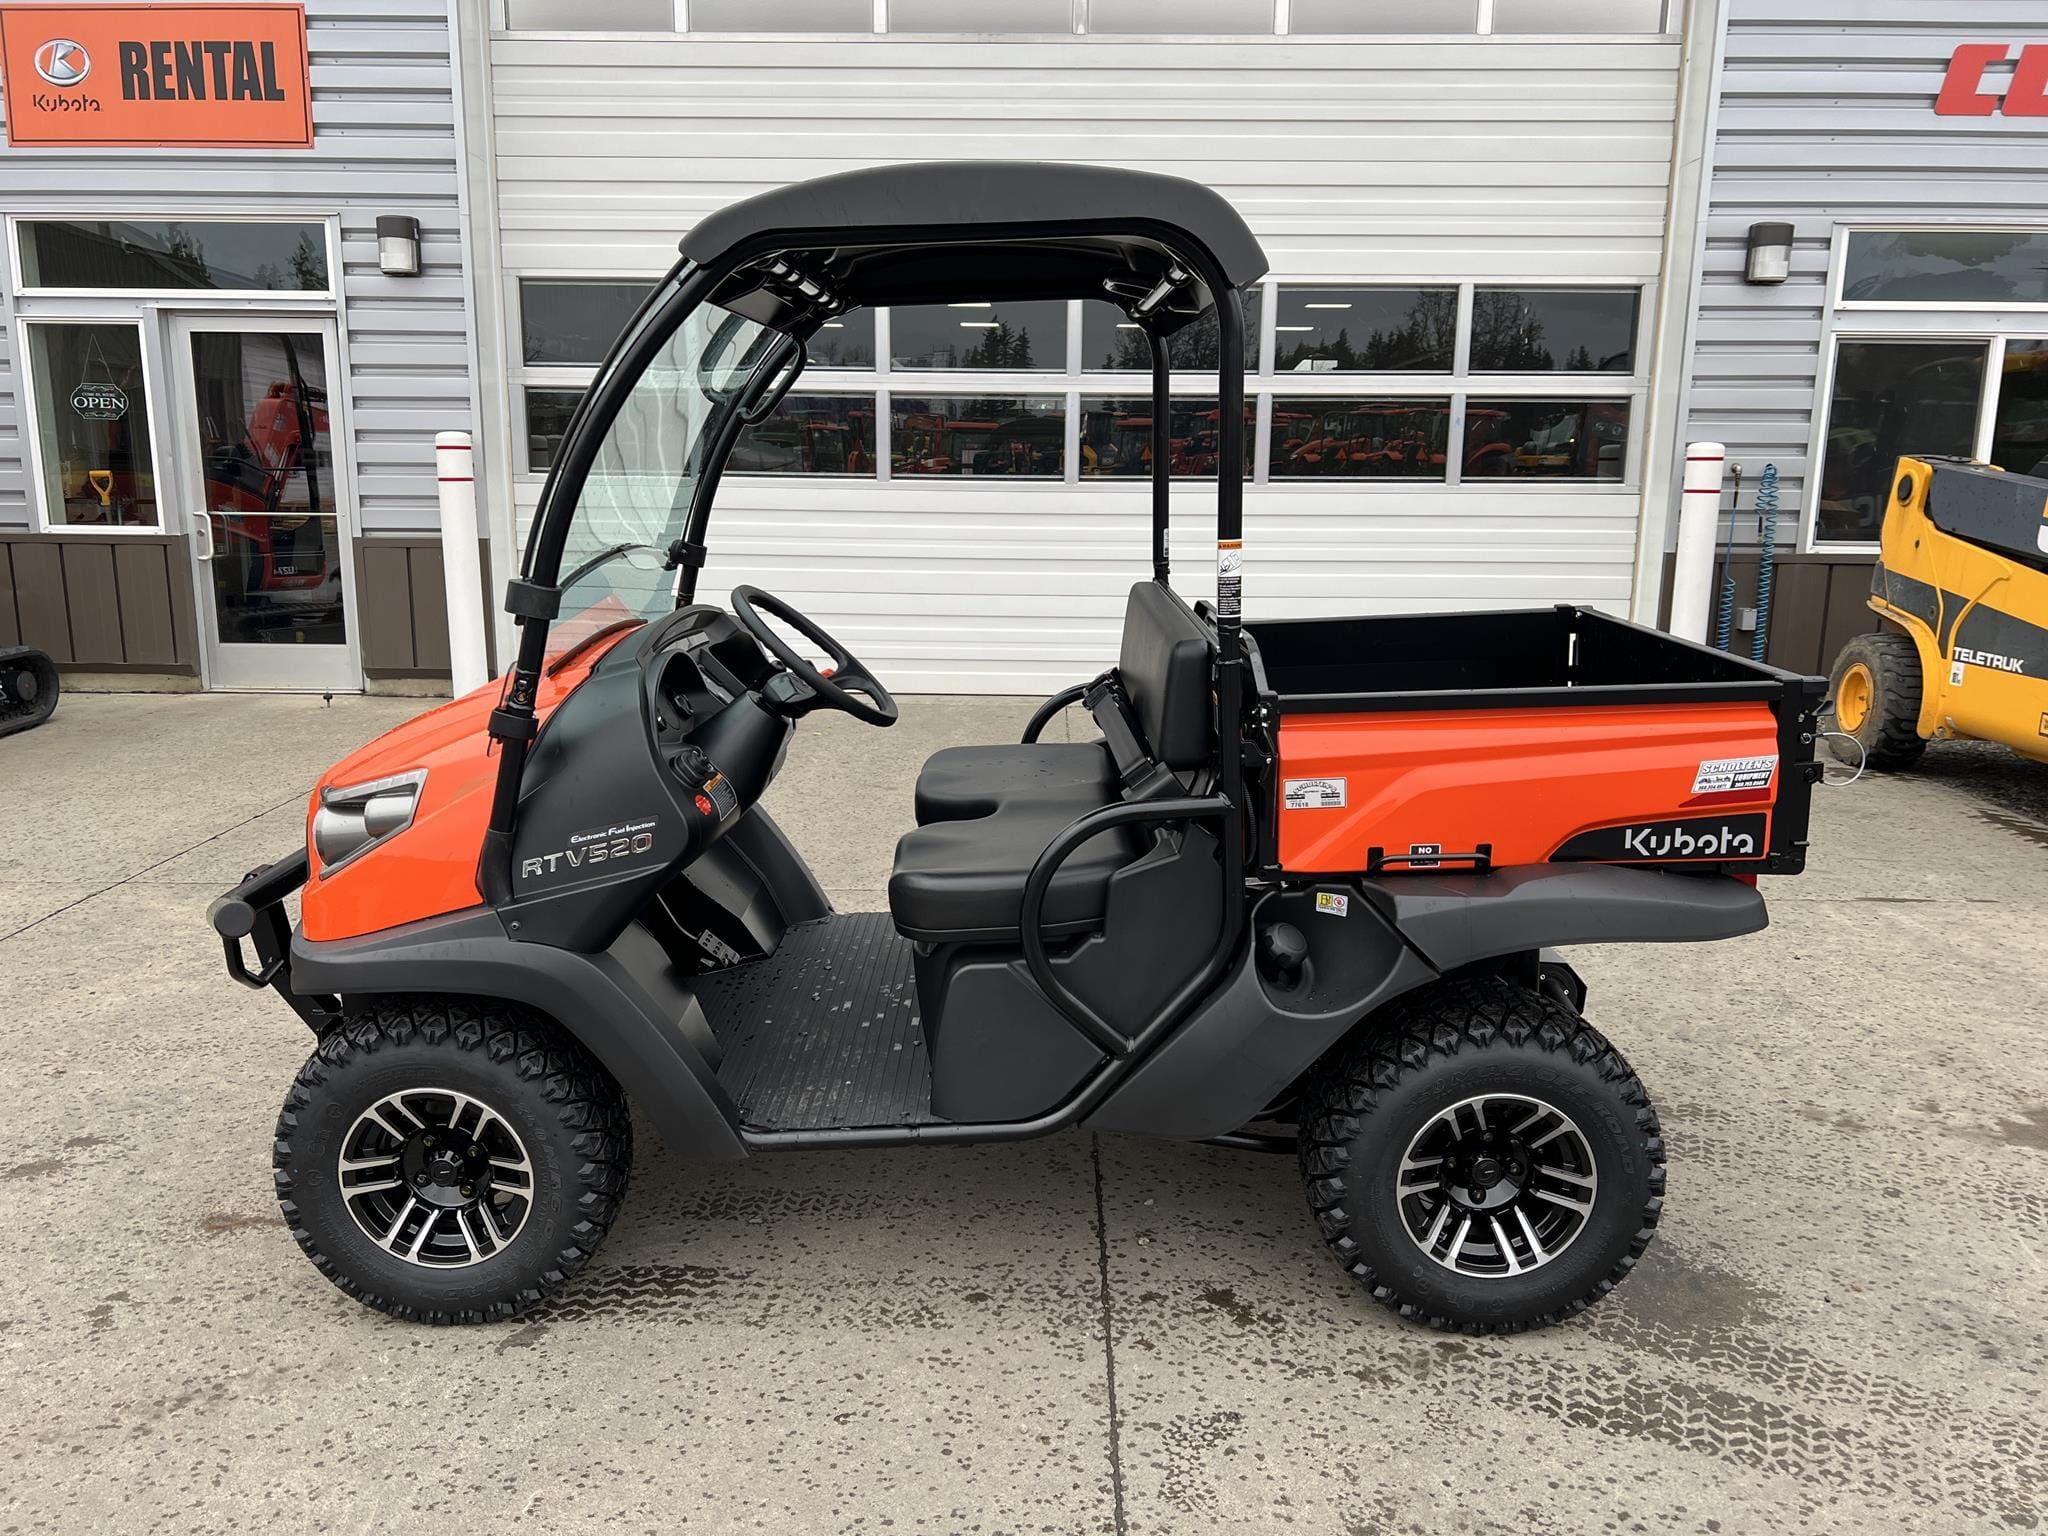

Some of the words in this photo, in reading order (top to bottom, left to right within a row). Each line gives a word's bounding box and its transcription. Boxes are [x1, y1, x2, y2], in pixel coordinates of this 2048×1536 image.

[118, 41, 285, 101] RENTAL
[33, 94, 100, 112] Kubota
[74, 396, 125, 409] OPEN
[1954, 646, 2024, 674] TELETRUK
[1702, 759, 1773, 774] SCHOLTEN'S
[571, 831, 607, 844] Electronic
[608, 827, 625, 836] Fuel
[626, 821, 656, 832] Injection
[1625, 826, 1754, 856] Kubota
[522, 832, 652, 878] RTV520
[1418, 846, 1433, 854] NO
